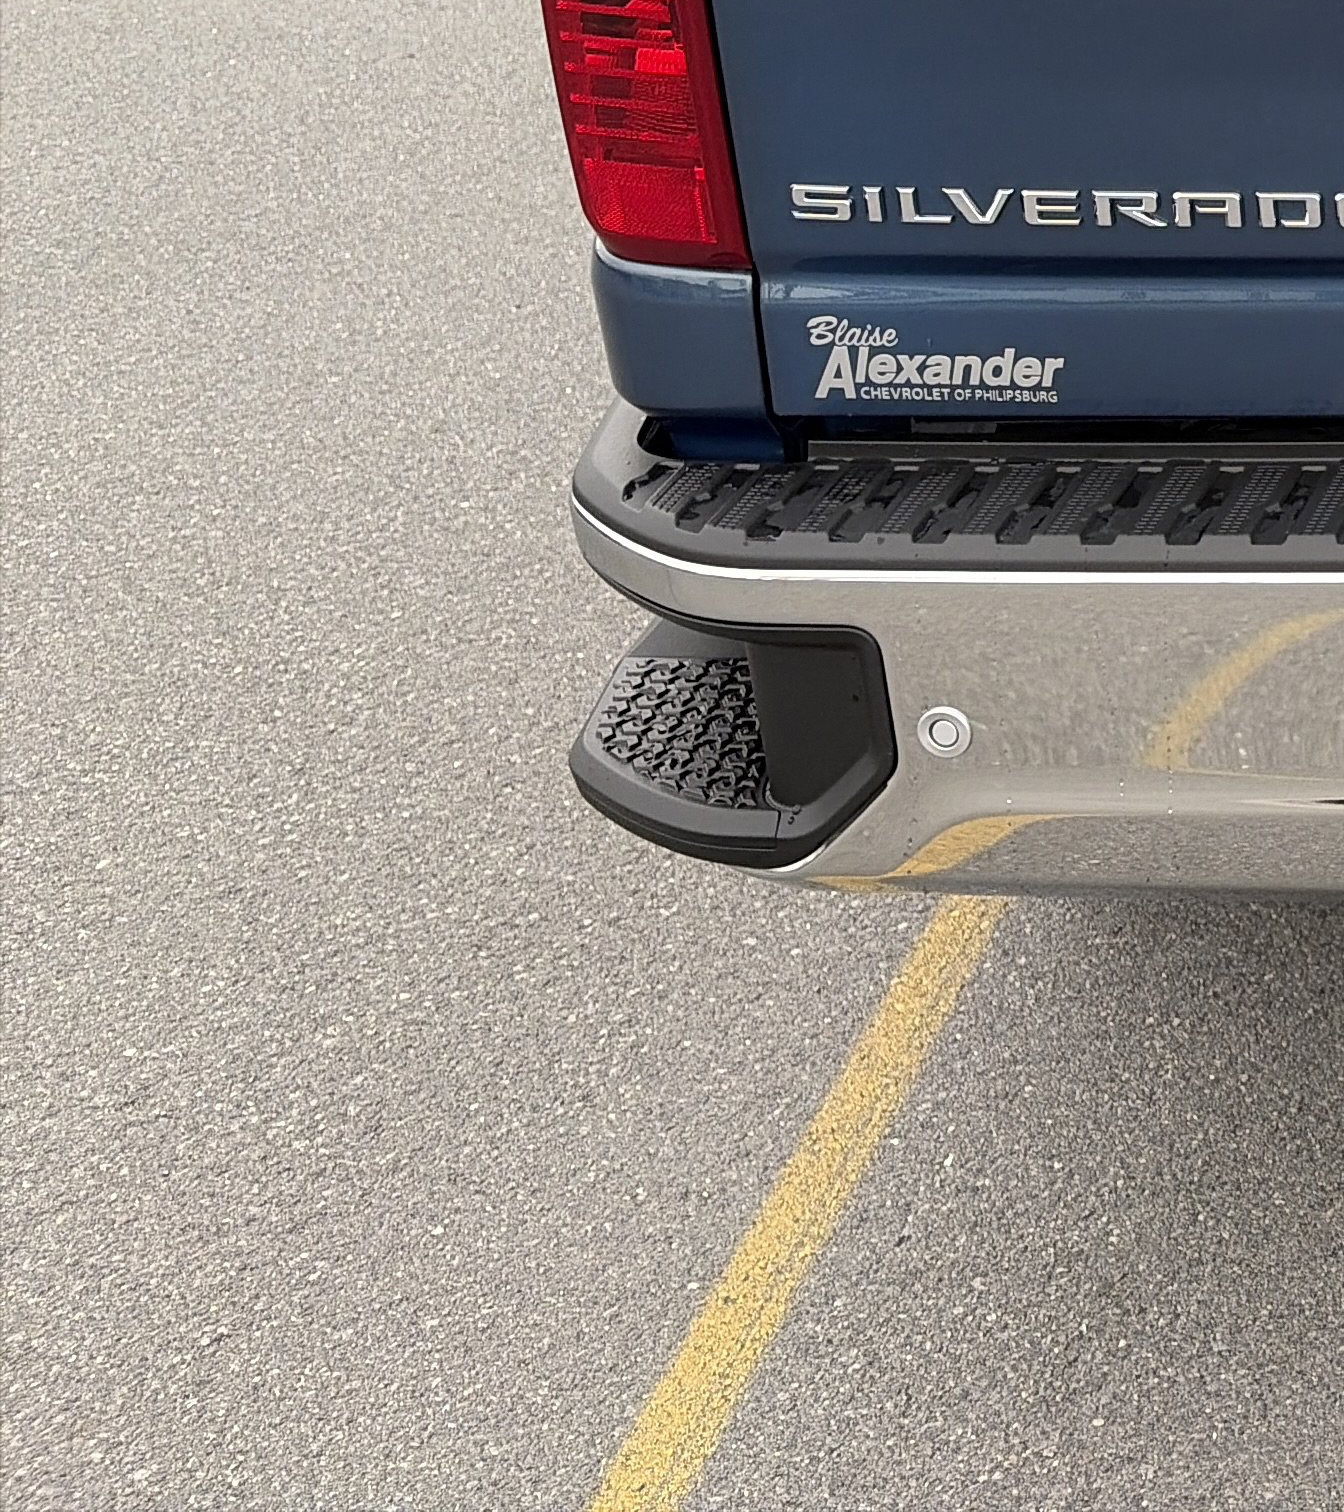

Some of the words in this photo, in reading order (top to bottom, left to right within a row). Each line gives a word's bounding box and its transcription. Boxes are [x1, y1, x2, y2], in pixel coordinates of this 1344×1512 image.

[806, 315, 899, 347] Blaise
[814, 345, 1065, 399] Alexander
[860, 386, 951, 400] CHEVROLET
[953, 388, 972, 400] OF
[975, 389, 1059, 403] PHILIPSBURG
